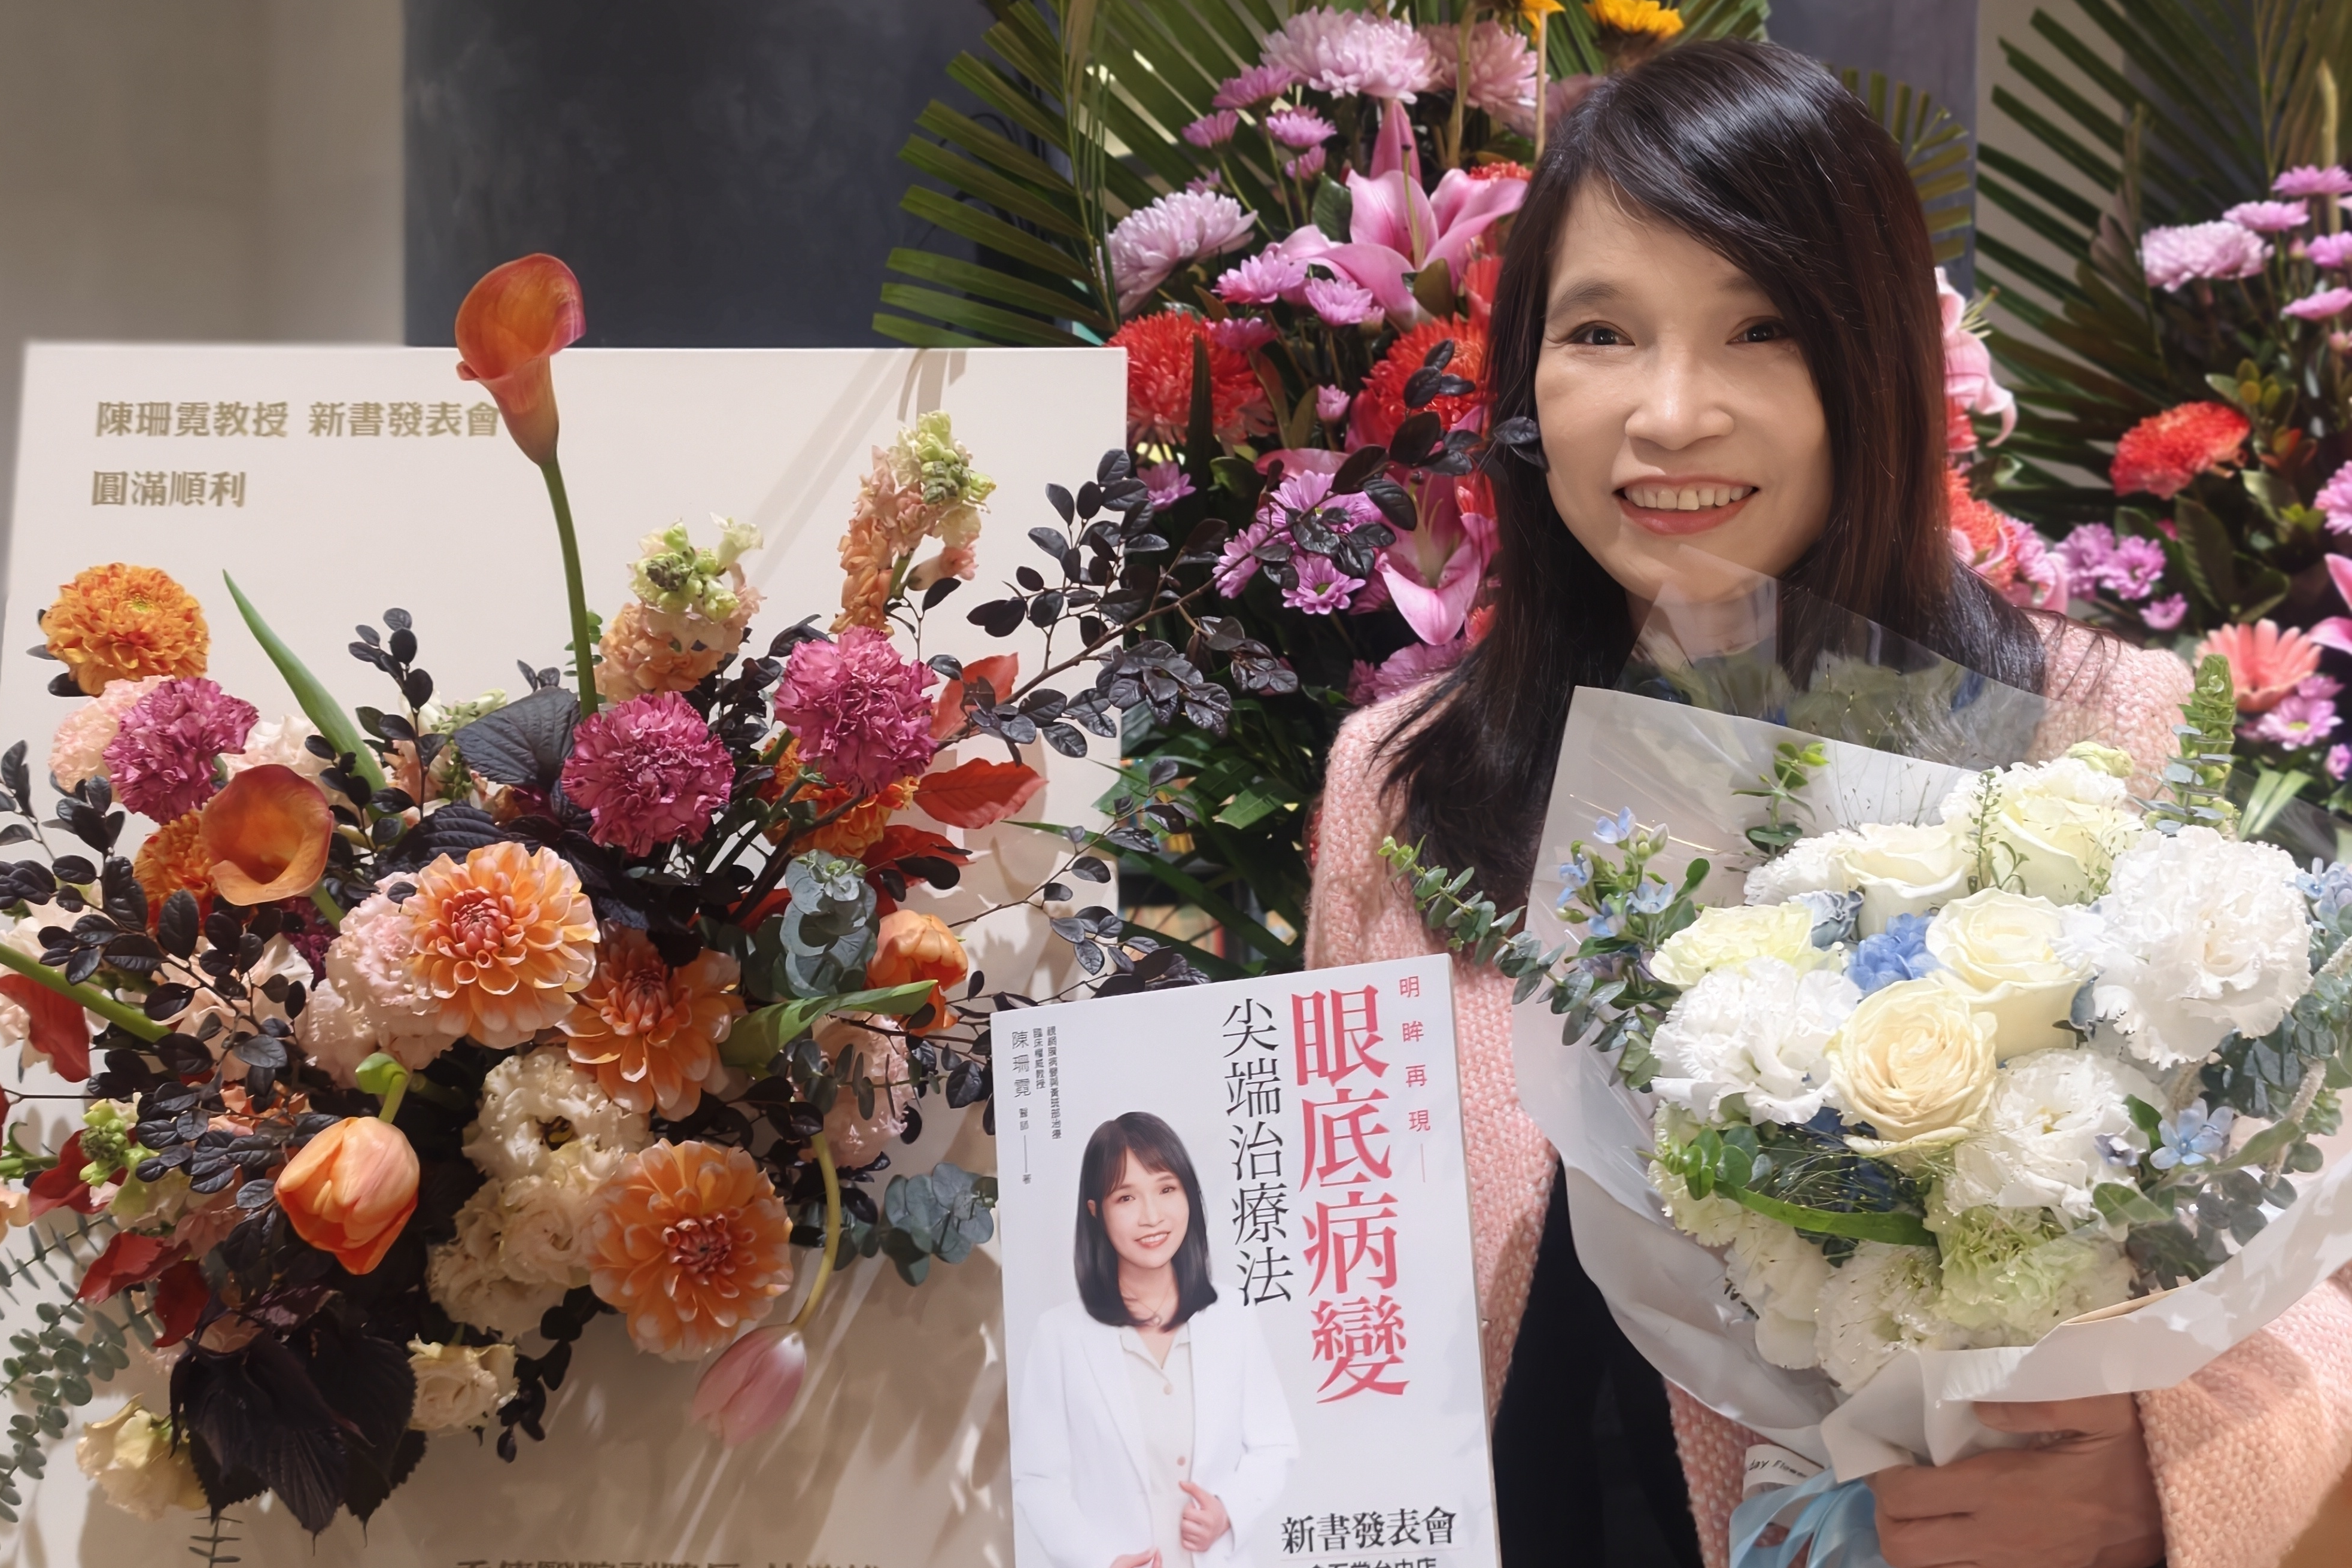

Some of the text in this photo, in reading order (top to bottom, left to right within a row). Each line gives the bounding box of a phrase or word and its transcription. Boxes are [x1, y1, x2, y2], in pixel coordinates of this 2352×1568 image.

[96, 402, 499, 437] 陳珊霓教授 新書發表會
[92, 471, 246, 508] 圓滿順利
[1011, 1031, 1031, 1098] 陳珊霓
[1399, 976, 1431, 1133] 明眸再現
[1222, 998, 1294, 1307] 尖端治療法
[1291, 984, 1409, 1404] 眼底病變
[1281, 1506, 1456, 1554] 新書發表會
